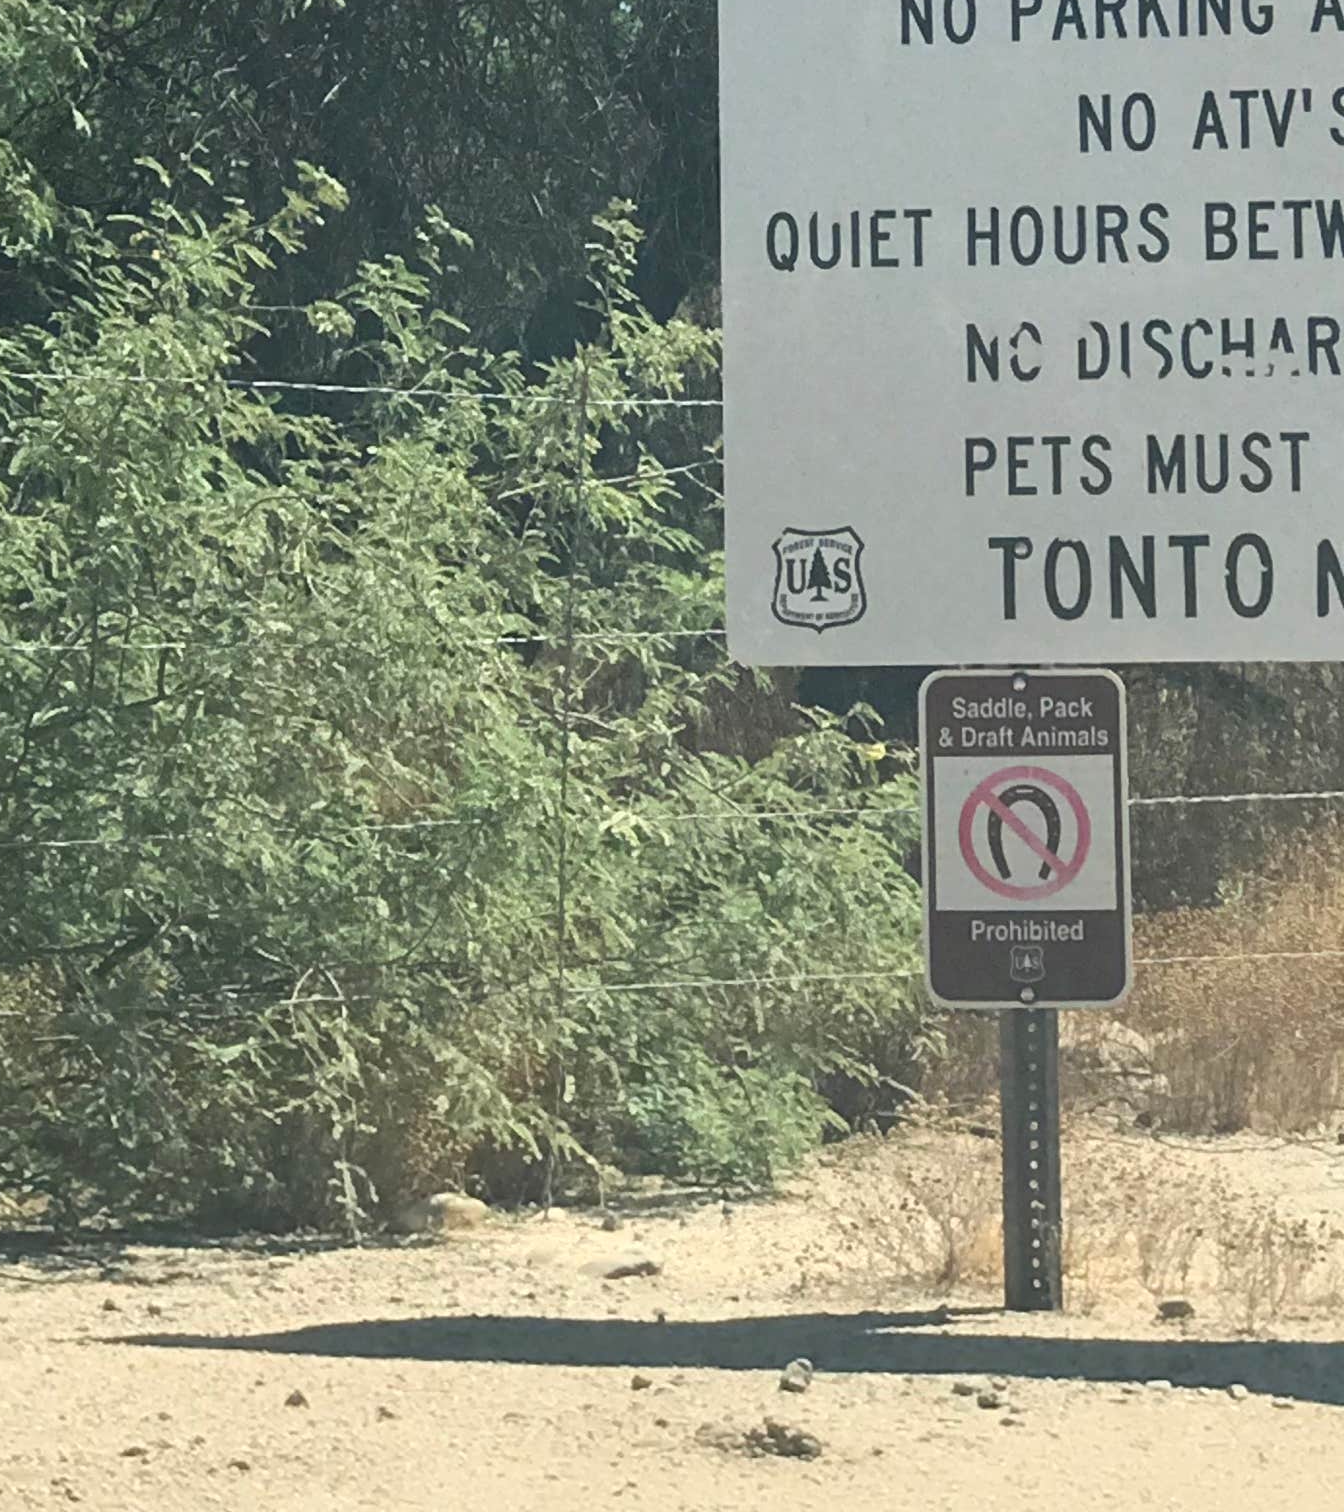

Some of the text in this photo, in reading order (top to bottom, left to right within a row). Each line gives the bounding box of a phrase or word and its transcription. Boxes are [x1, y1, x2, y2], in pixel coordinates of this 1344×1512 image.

[1077, 91, 1157, 153] NO
[765, 208, 933, 273] QUIET
[966, 202, 1171, 267] HOURS
[966, 320, 1043, 383] NO
[964, 434, 1114, 496] PETS
[1146, 431, 1310, 495] MUST
[988, 532, 1275, 621] TONTO
[938, 726, 1109, 748] & Draft Animals
[951, 696, 1094, 721] Saddle, Pack
[971, 919, 1085, 942] Prohibited
